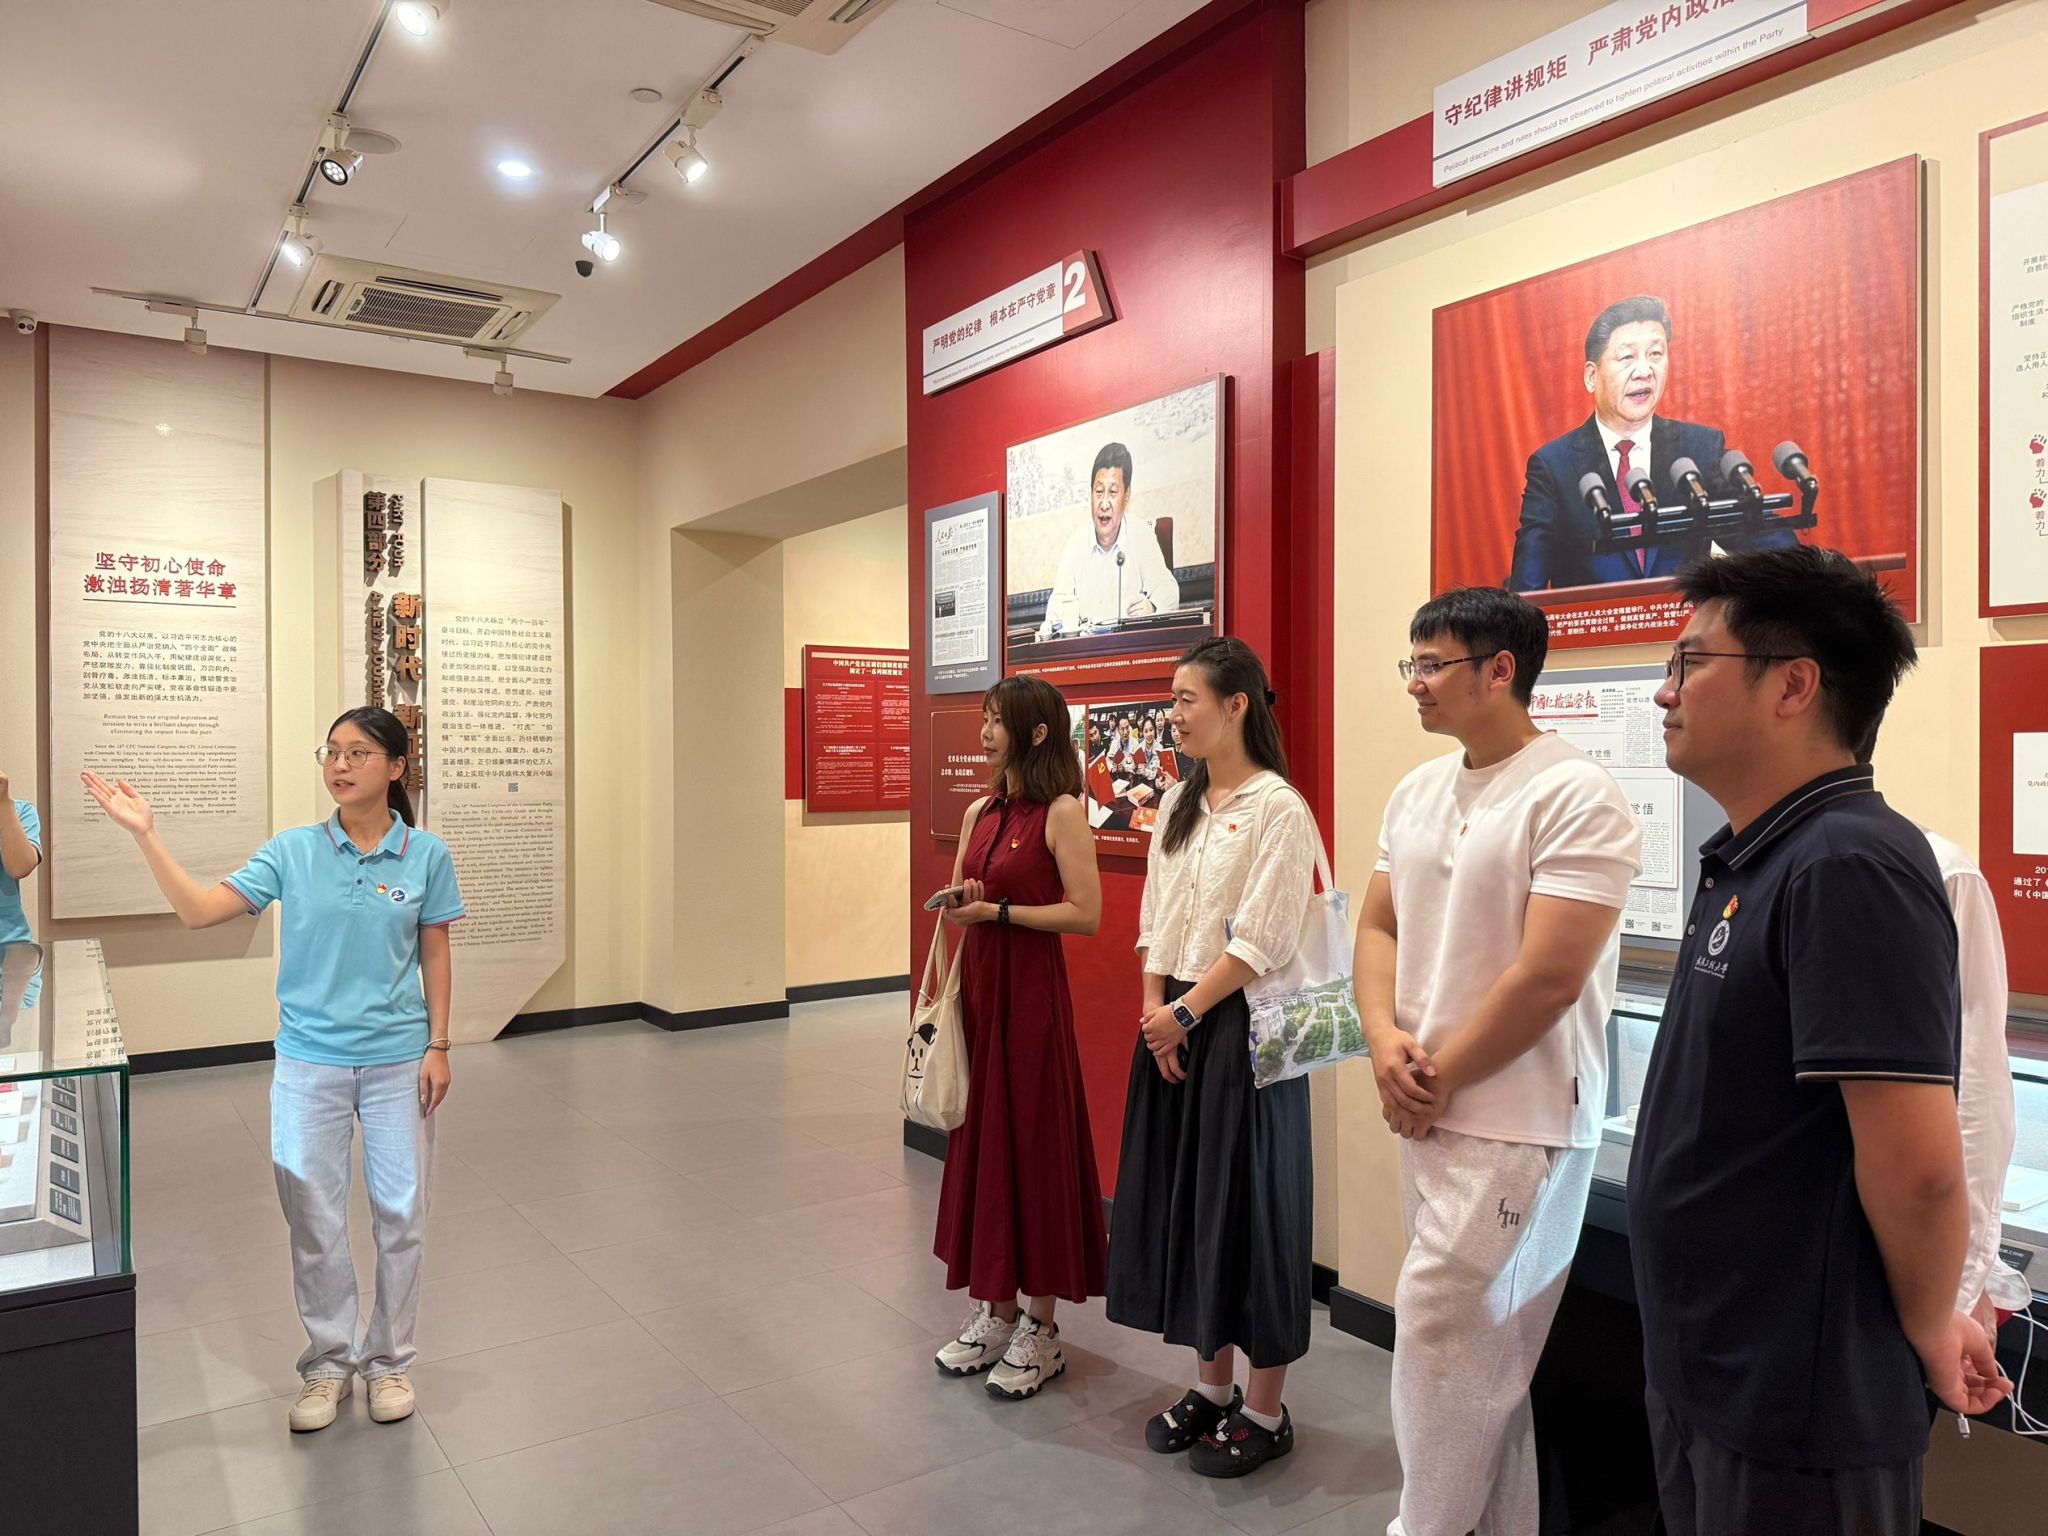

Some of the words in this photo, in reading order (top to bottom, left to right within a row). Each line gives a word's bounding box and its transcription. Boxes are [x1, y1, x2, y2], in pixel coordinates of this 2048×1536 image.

[1444, 54, 1567, 126] 守纪律讲规矩
[1444, 156, 1468, 172] Political
[1469, 146, 1500, 163] discipline
[1501, 139, 1514, 150] and
[1515, 132, 1532, 143] rules
[1534, 120, 1558, 136] should
[1559, 116, 1568, 126] be
[1570, 102, 1605, 121] observed
[1606, 96, 1614, 107] to
[1616, 86, 1642, 105] tighten
[1644, 72, 1674, 92] political
[1677, 58, 1713, 77] activities
[1715, 46, 1740, 61] within
[1742, 38, 1757, 51] the
[1760, 27, 1784, 43] Party
[1063, 261, 1086, 314] 2
[933, 318, 982, 354] 严明党的纪律
[990, 282, 1056, 327] 根本在严守党章
[2035, 458, 2045, 480] 着力
[367, 491, 386, 572] 第四部分
[396, 494, 404, 525] PART
[2035, 511, 2045, 531] 着力
[95, 552, 226, 577] 坚守初心使命
[396, 533, 404, 568] FOUR
[84, 574, 236, 599] 激浊扬清著华章
[371, 606, 384, 644] NEW
[394, 592, 422, 682] 新时代
[371, 644, 385, 708] JOURNE
